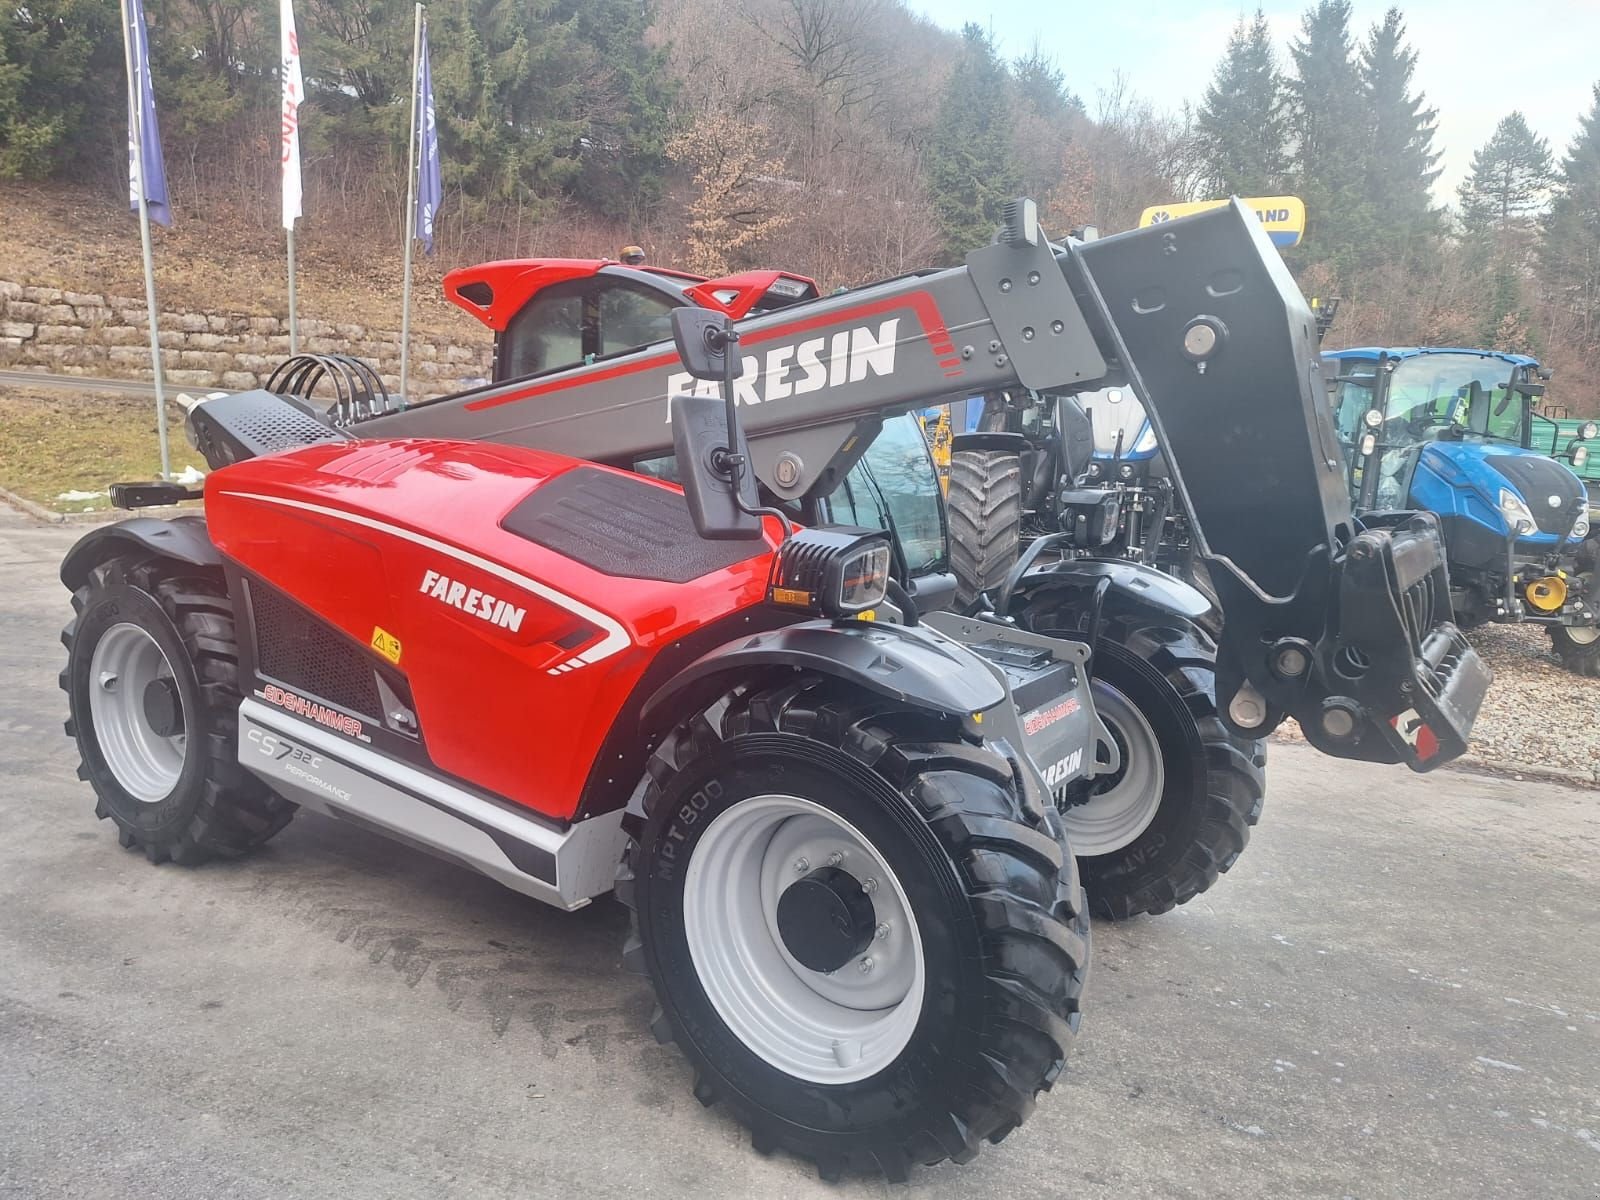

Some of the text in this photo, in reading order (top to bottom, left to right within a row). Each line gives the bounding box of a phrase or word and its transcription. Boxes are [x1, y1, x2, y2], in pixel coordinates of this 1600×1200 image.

[419, 569, 527, 633] FARESIN
[264, 684, 362, 737] EIDENHAMMER
[285, 763, 352, 801] PERFORMANCE
[679, 780, 723, 825] 800
